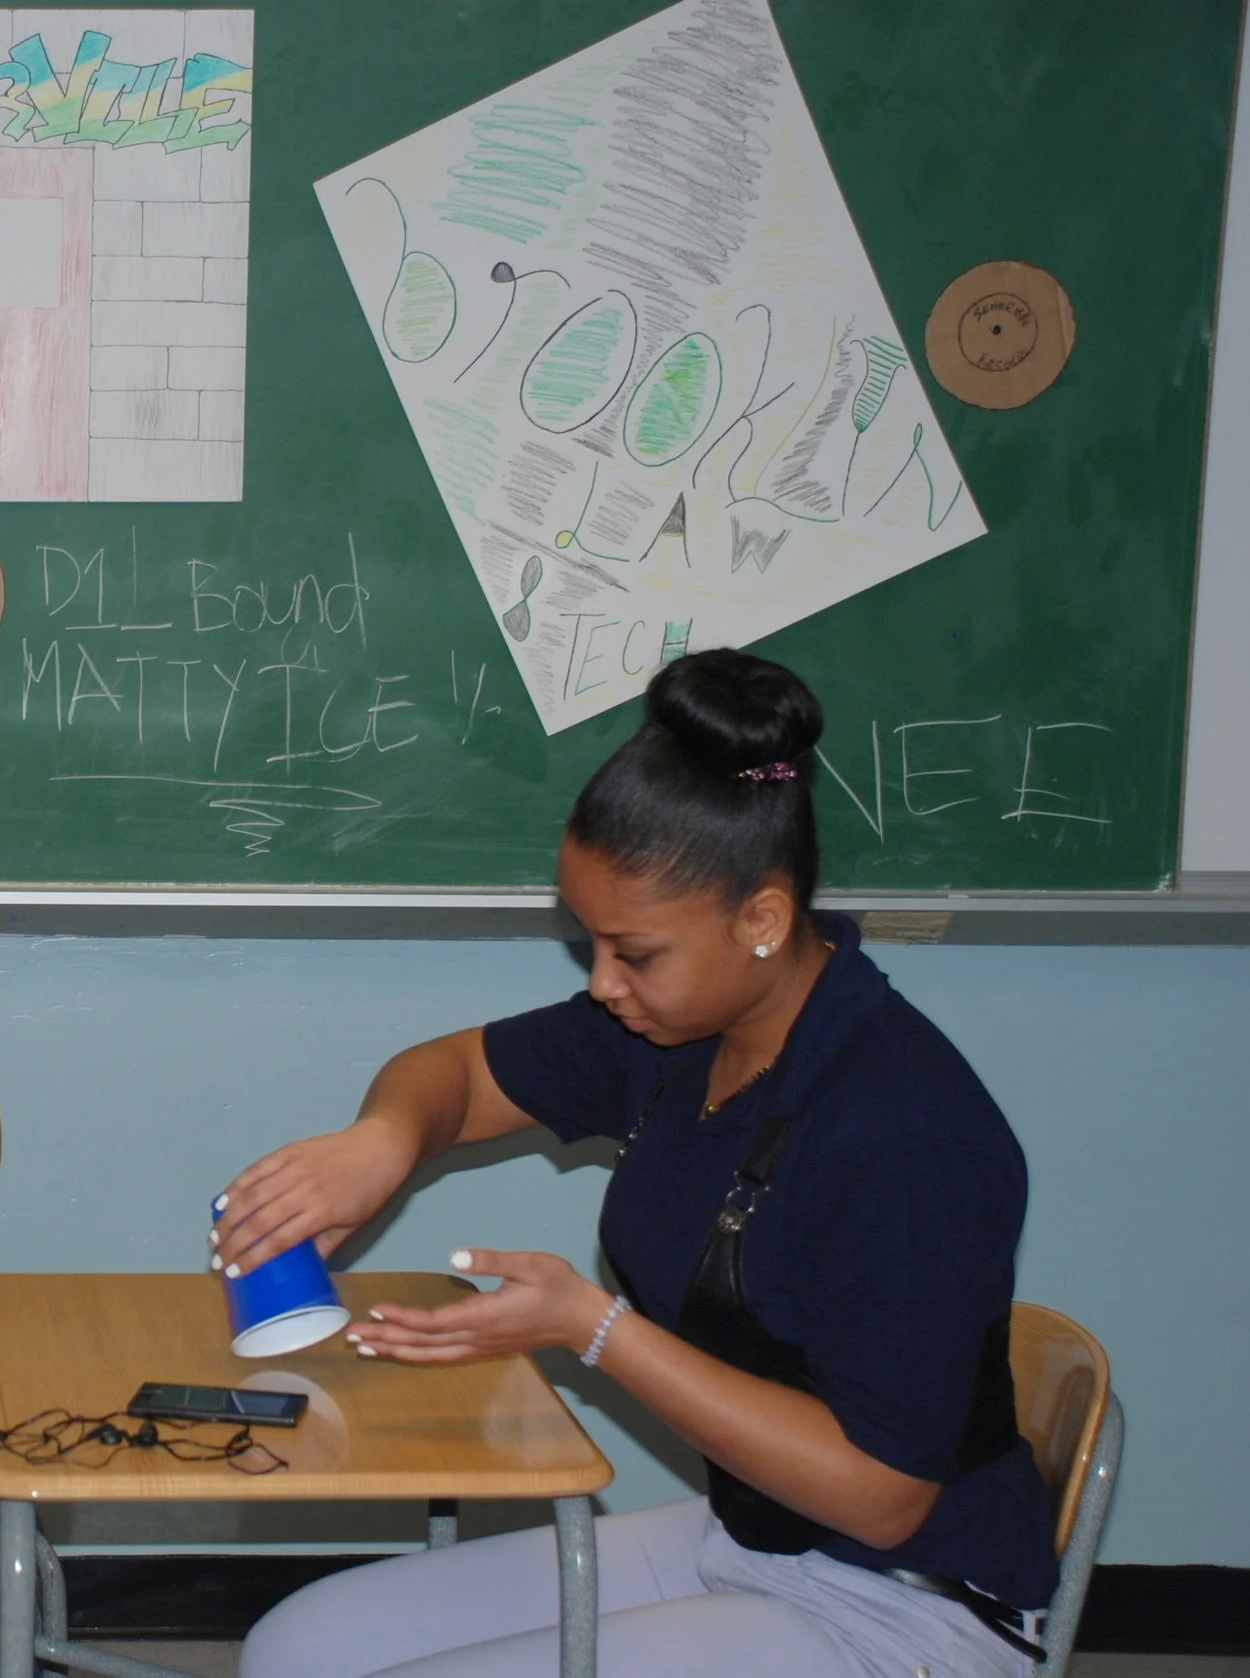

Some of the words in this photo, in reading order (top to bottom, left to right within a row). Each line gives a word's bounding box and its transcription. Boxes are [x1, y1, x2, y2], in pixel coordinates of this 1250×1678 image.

[555, 461, 792, 574] LAW
[187, 532, 370, 650] Bound
[22, 637, 247, 773] MATTY
[559, 612, 694, 700] TECH
